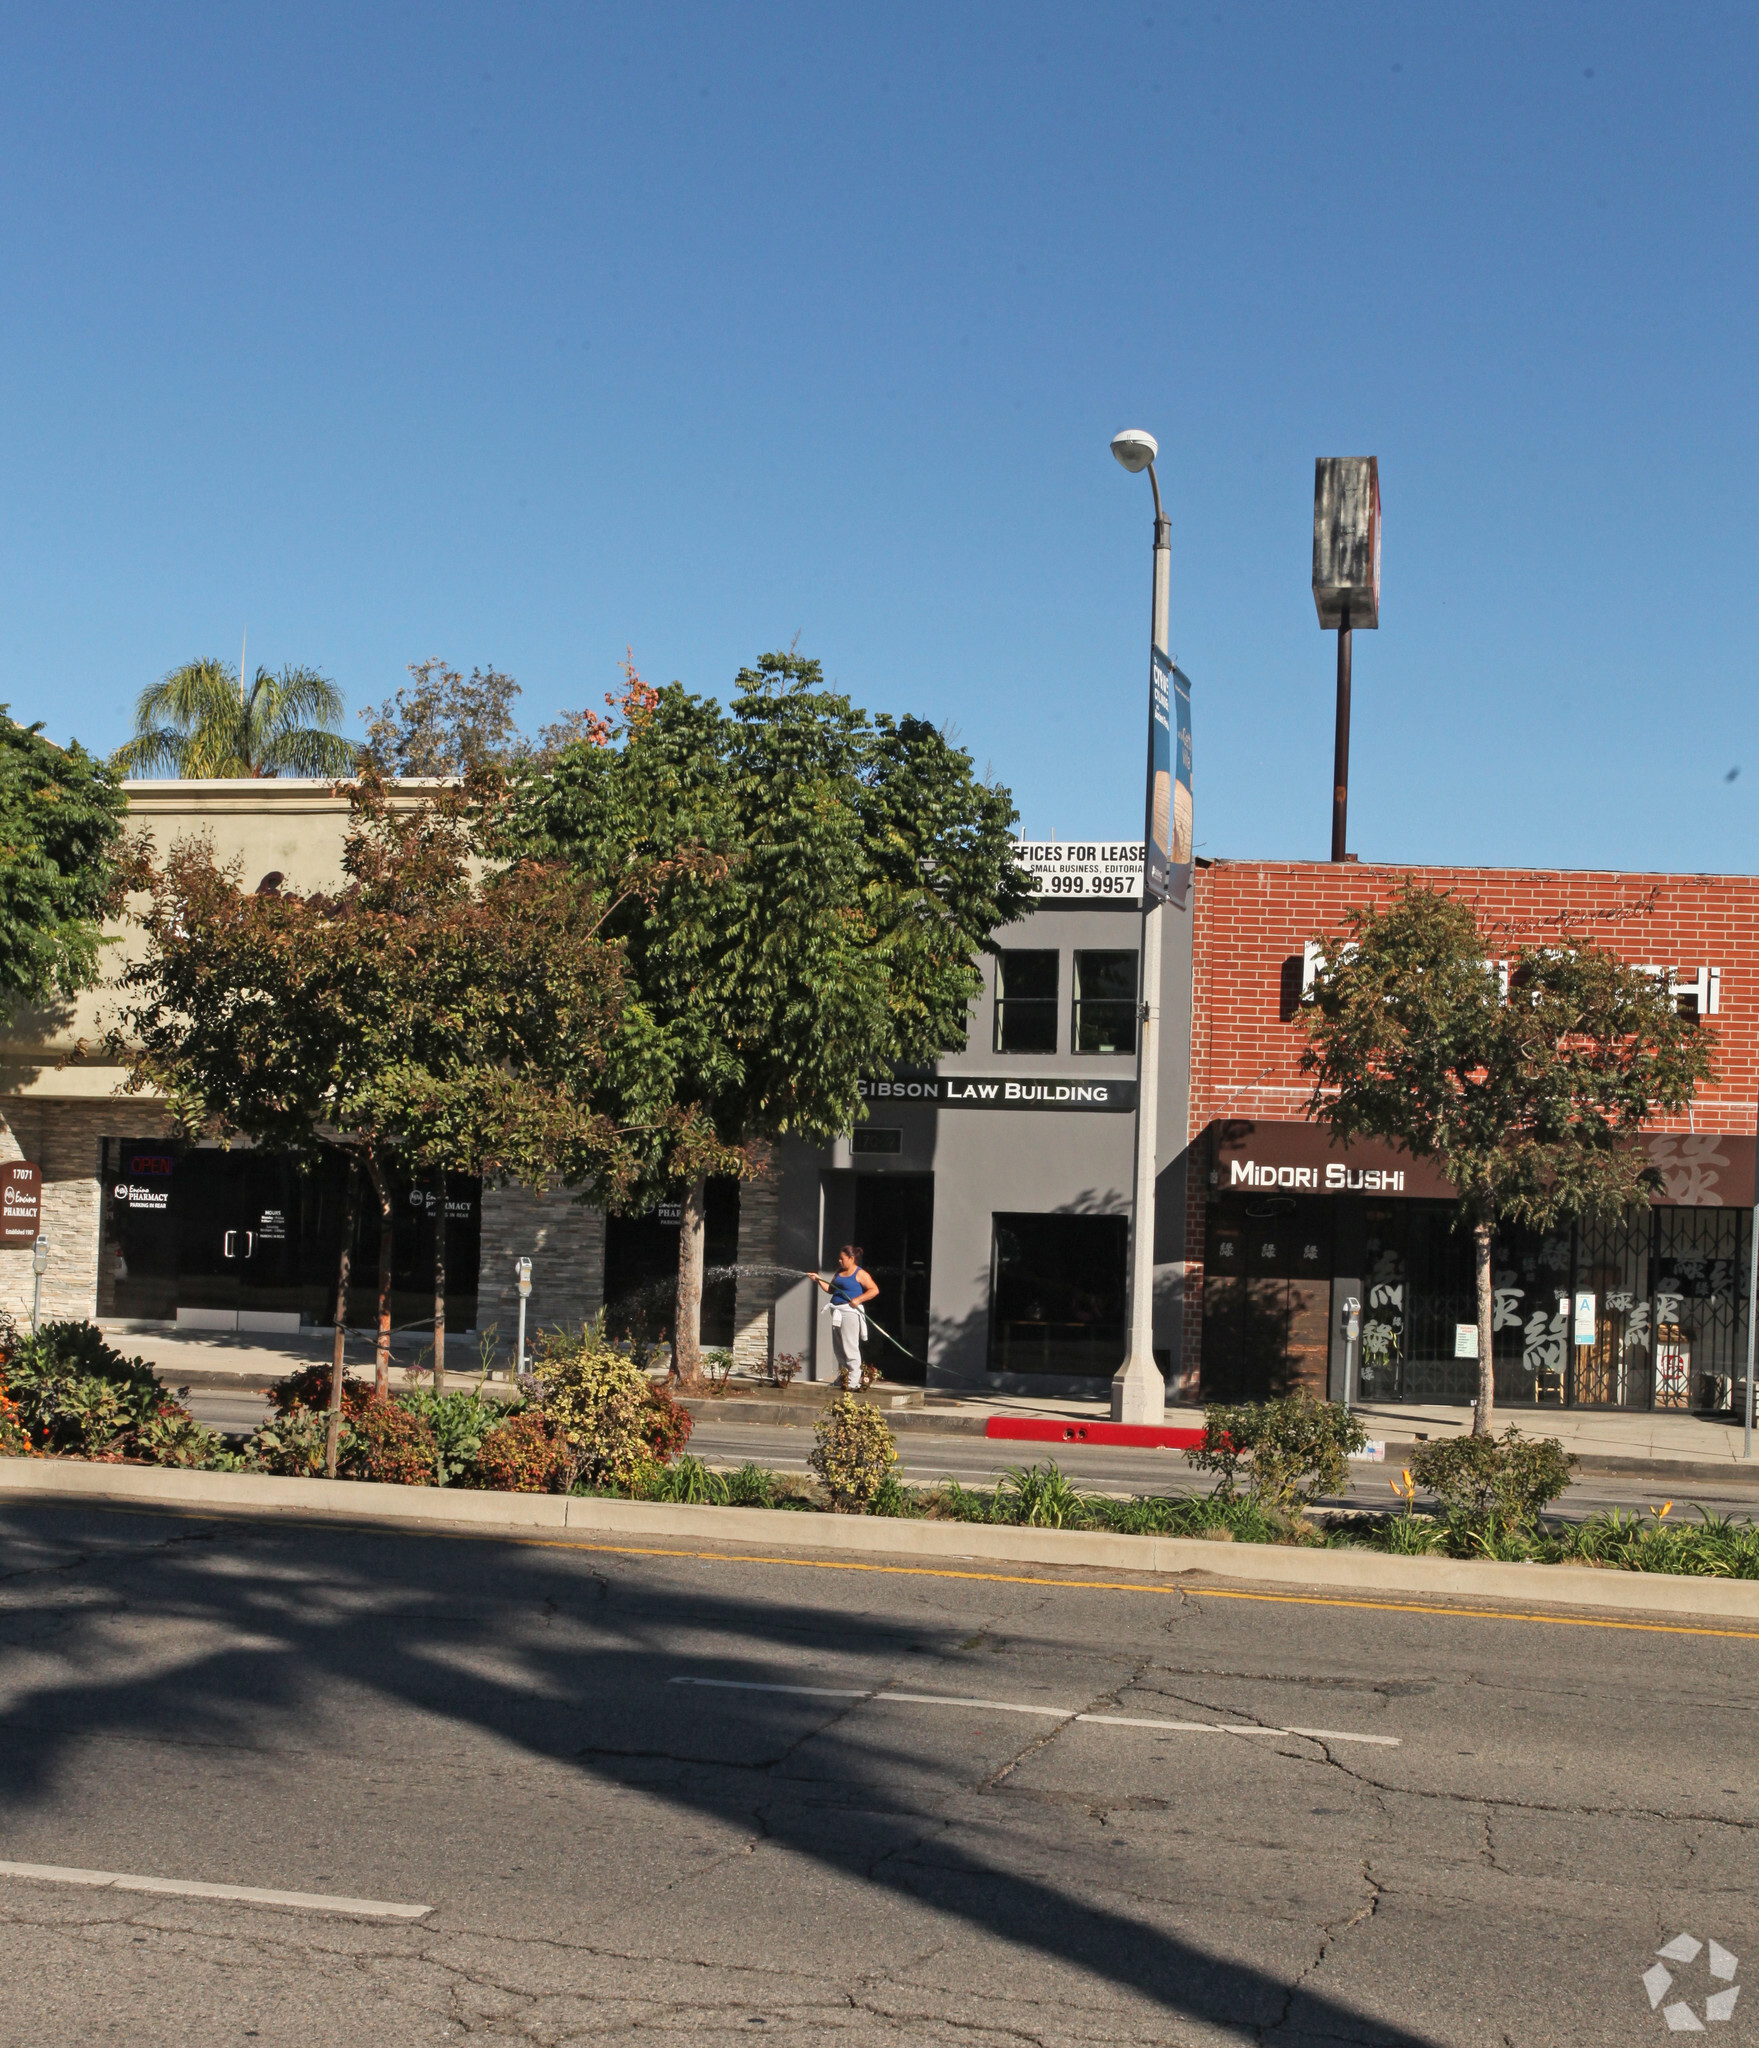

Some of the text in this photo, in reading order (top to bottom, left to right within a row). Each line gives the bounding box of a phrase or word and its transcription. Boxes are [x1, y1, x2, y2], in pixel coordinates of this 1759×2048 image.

[1067, 846, 1097, 861] FOR
[1101, 846, 1146, 861] LEASE
[1030, 864, 1057, 873] SMALL
[1060, 865, 1102, 875] BUSINESS,
[1105, 865, 1143, 873] EDITORIA
[856, 1079, 1109, 1102] GIBSON LAW BUILDING
[131, 1157, 170, 1174] OPEN
[13, 1168, 33, 1180] 17071
[129, 1184, 149, 1193] Encino
[15, 1190, 37, 1204] Encino
[129, 1192, 169, 1202] PHARMACY
[3, 1206, 38, 1218] PHARMACY
[1580, 1298, 1591, 1312] A
